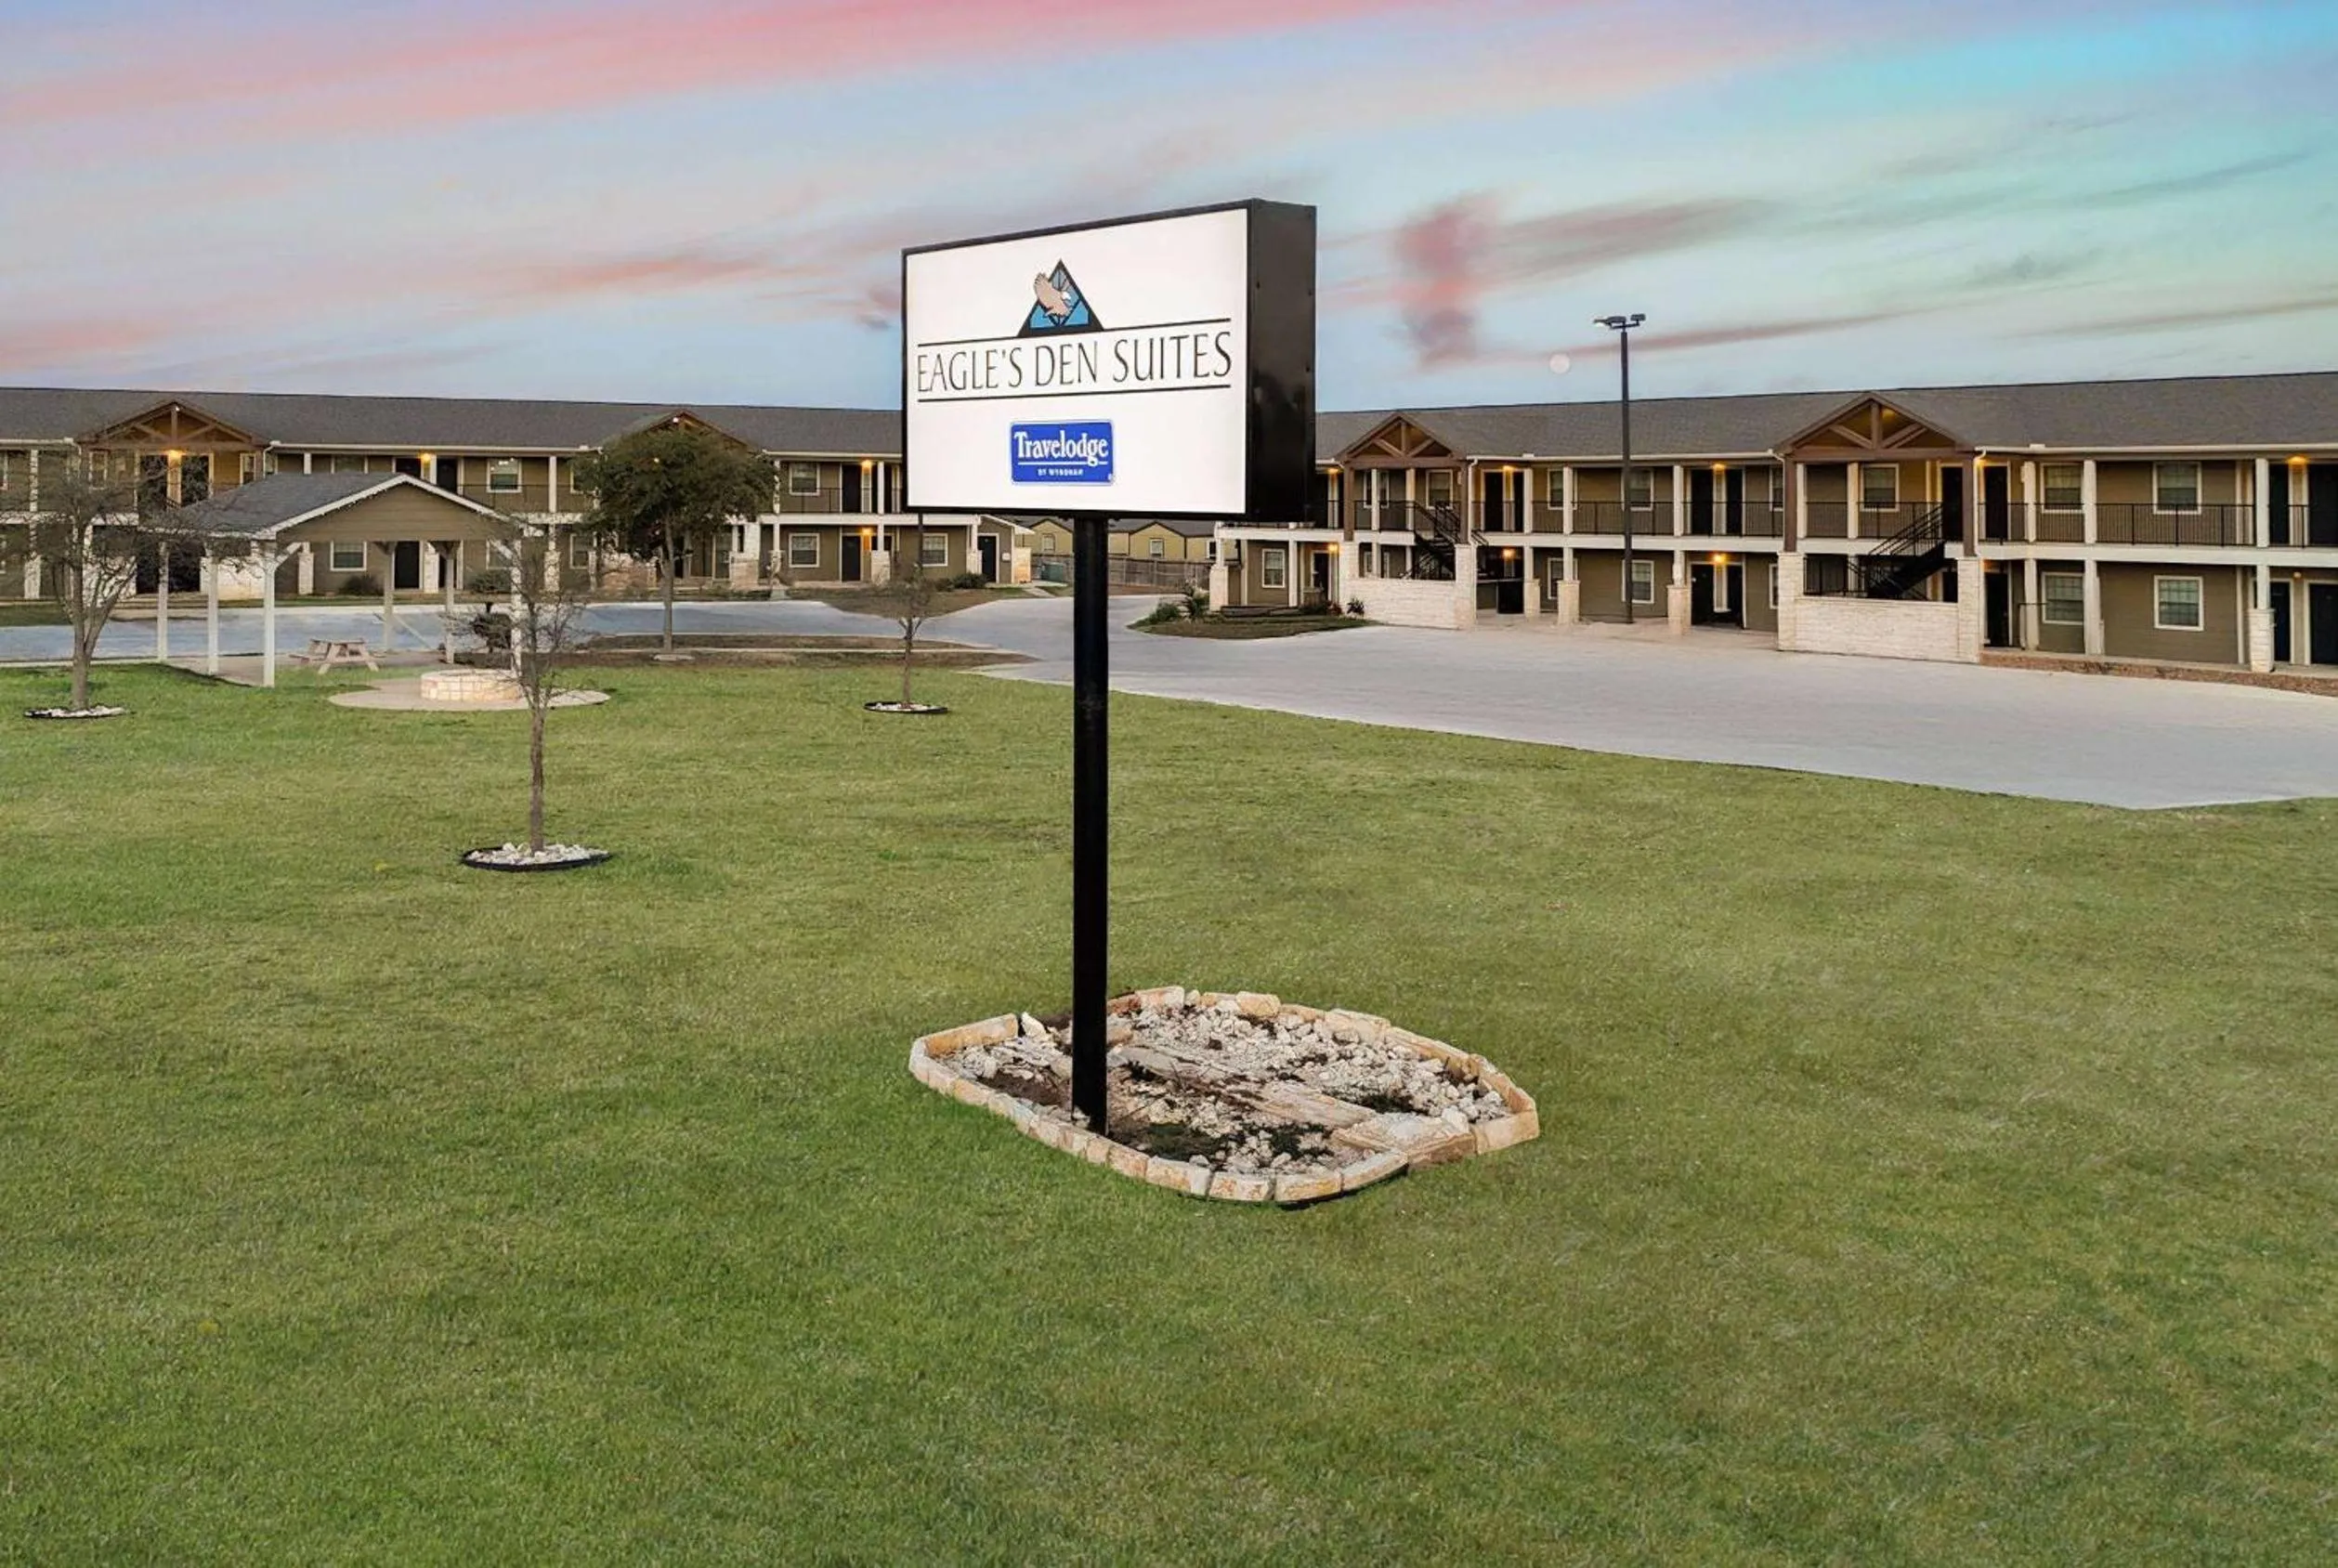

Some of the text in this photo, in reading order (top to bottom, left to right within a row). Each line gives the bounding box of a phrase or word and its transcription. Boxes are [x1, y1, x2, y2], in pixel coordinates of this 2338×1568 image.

[918, 331, 1233, 392] EAGLE'S DEN SUITES
[1013, 430, 1109, 466] Travelodge
